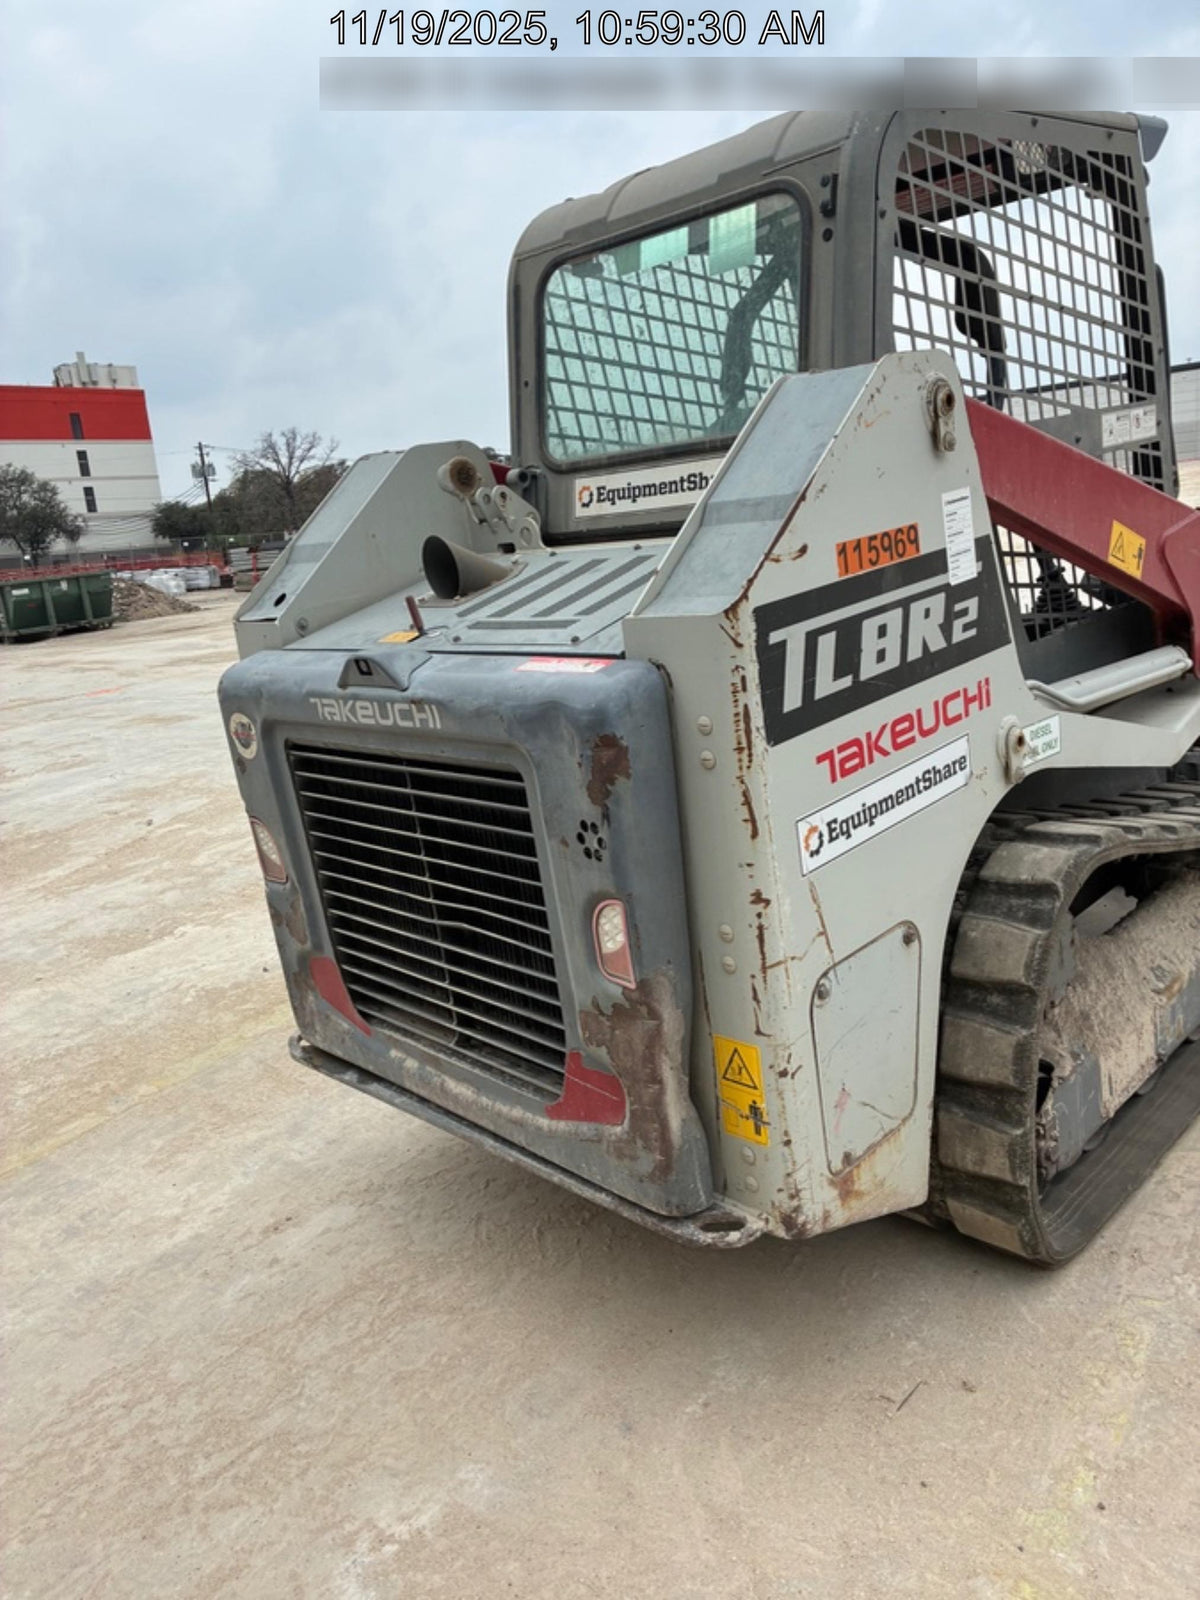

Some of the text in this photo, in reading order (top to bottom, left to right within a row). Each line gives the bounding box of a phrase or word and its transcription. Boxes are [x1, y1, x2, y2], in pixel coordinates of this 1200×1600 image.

[595, 471, 715, 506] EquipmentSh
[837, 523, 921, 575] 115969
[825, 754, 968, 844] EquipmentShare
